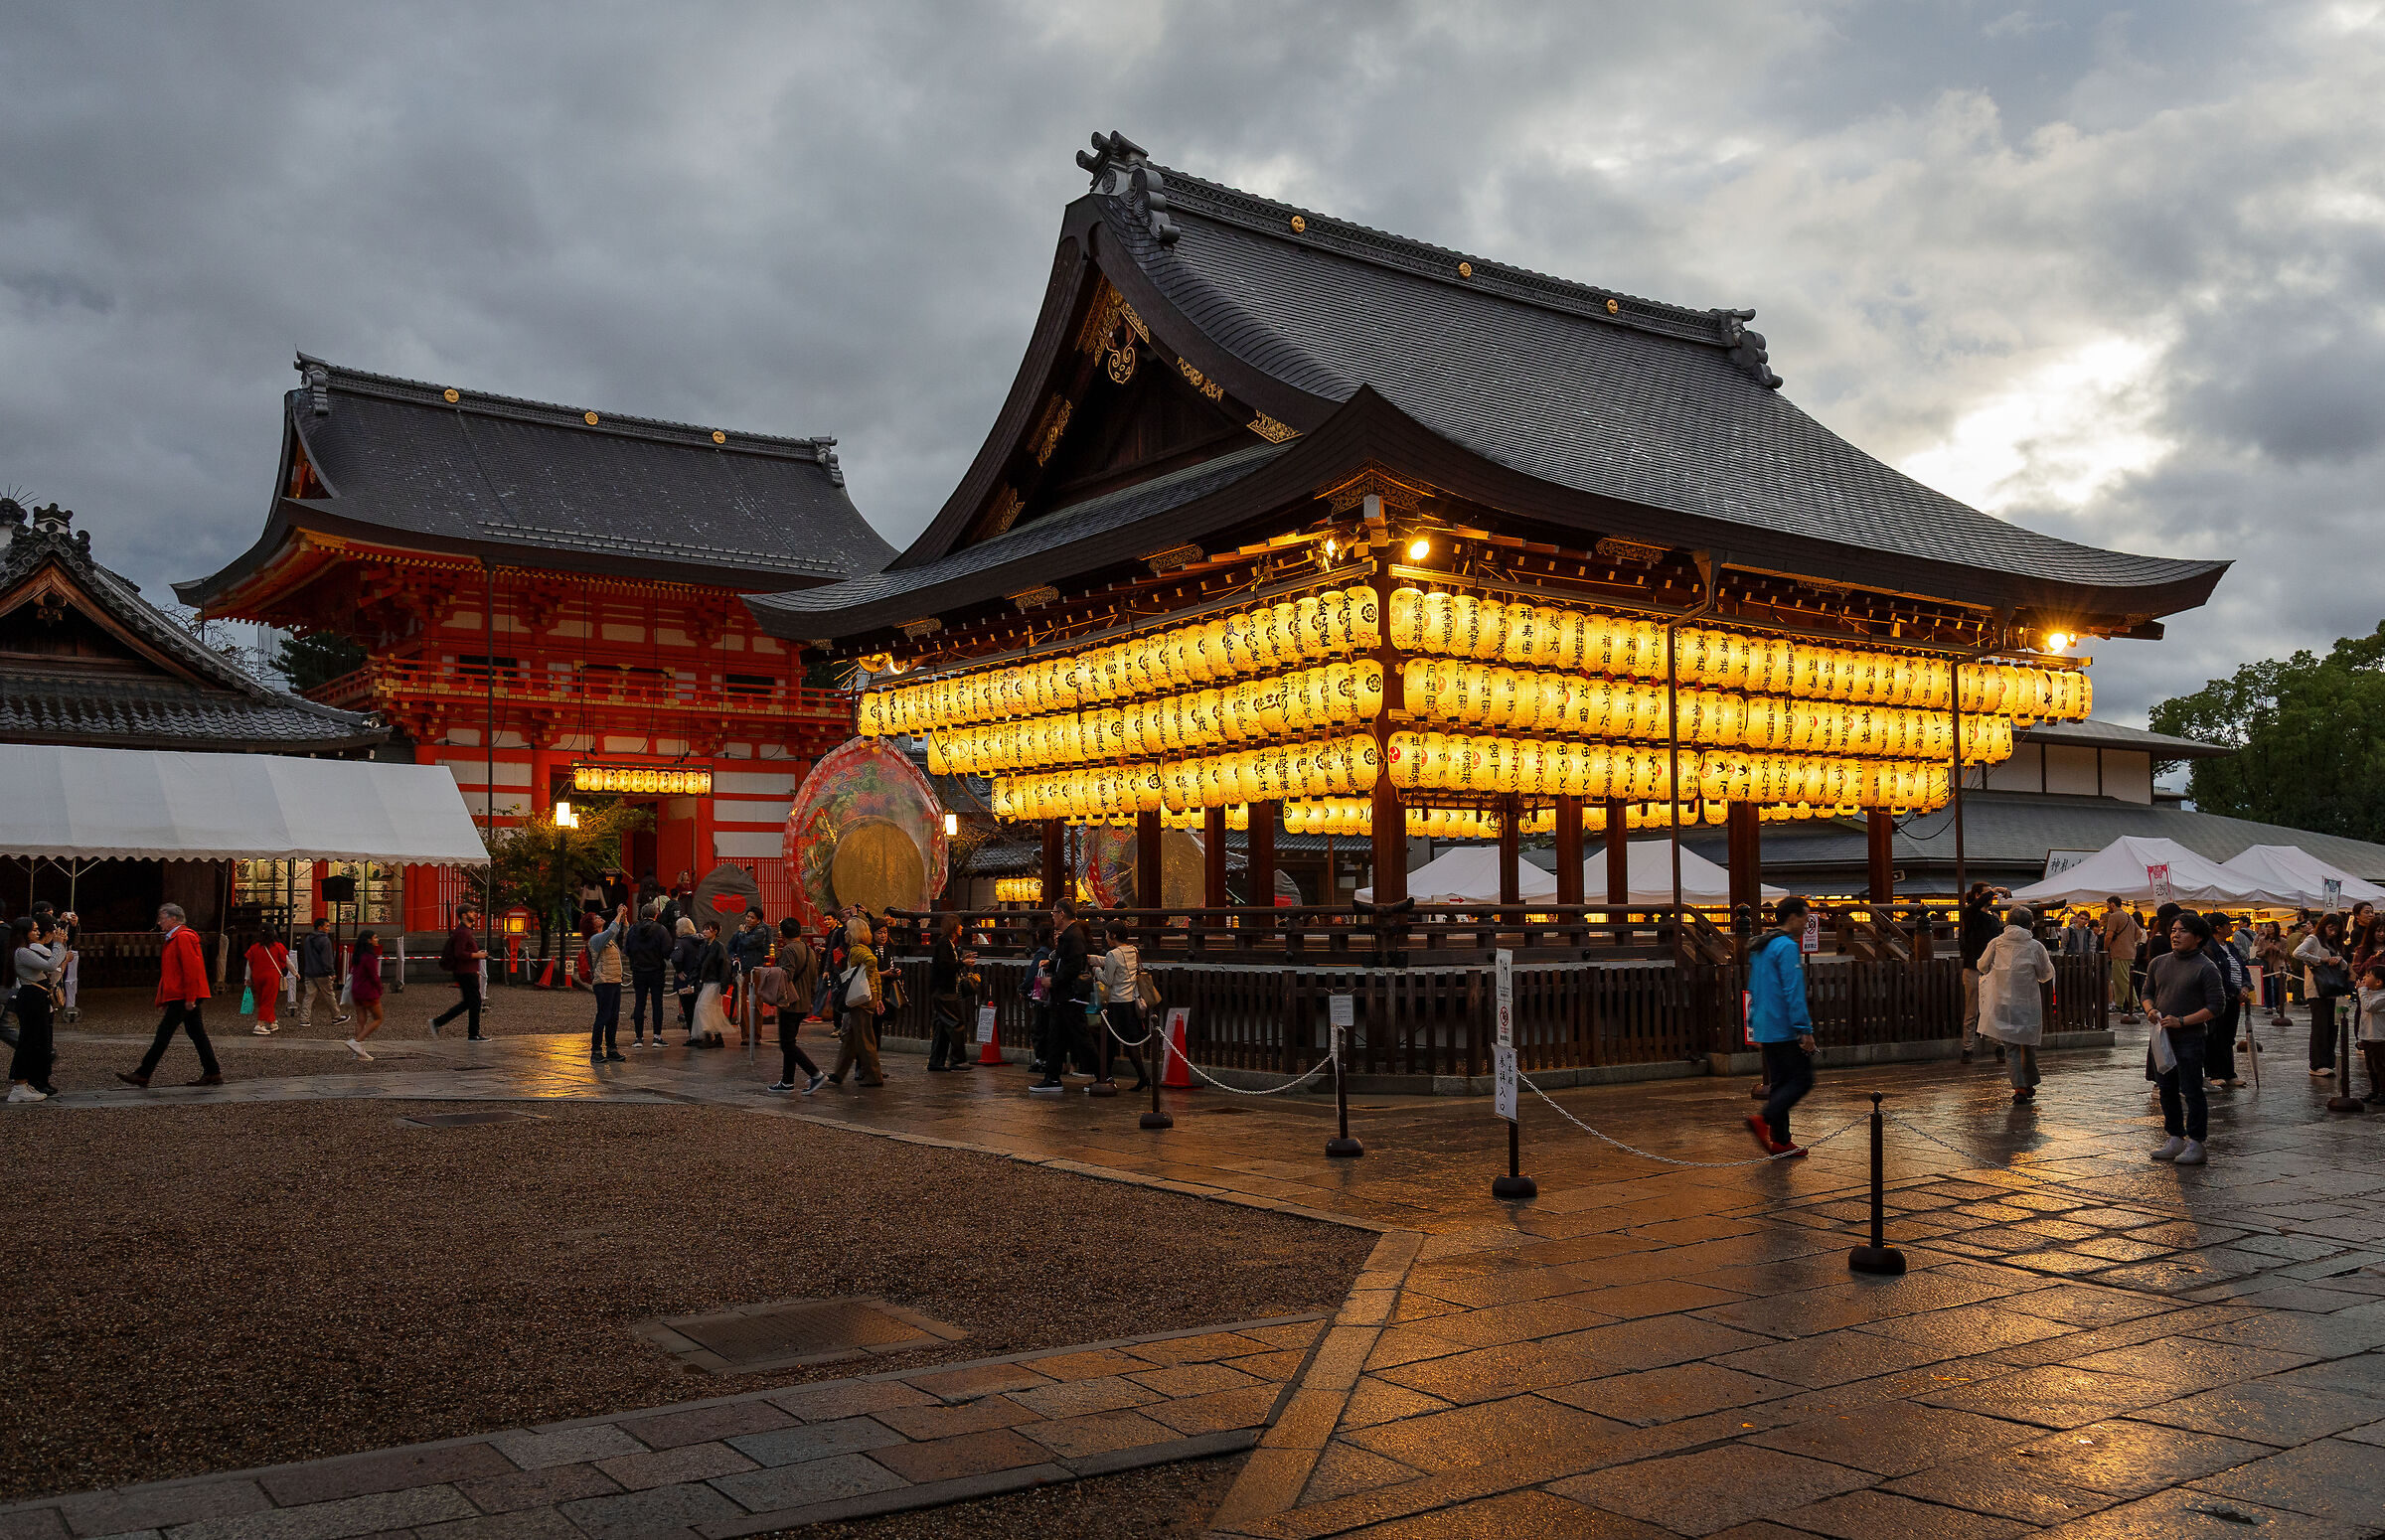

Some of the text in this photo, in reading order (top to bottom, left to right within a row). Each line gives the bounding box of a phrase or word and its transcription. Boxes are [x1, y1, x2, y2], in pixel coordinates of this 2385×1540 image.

[1519, 607, 1534, 655] 福寿園
[1424, 663, 1438, 710] 月桂冠
[1456, 662, 1468, 710] 月桂冠
[1481, 669, 1492, 714] 月桂冠
[1489, 742, 1501, 779] 宮下
